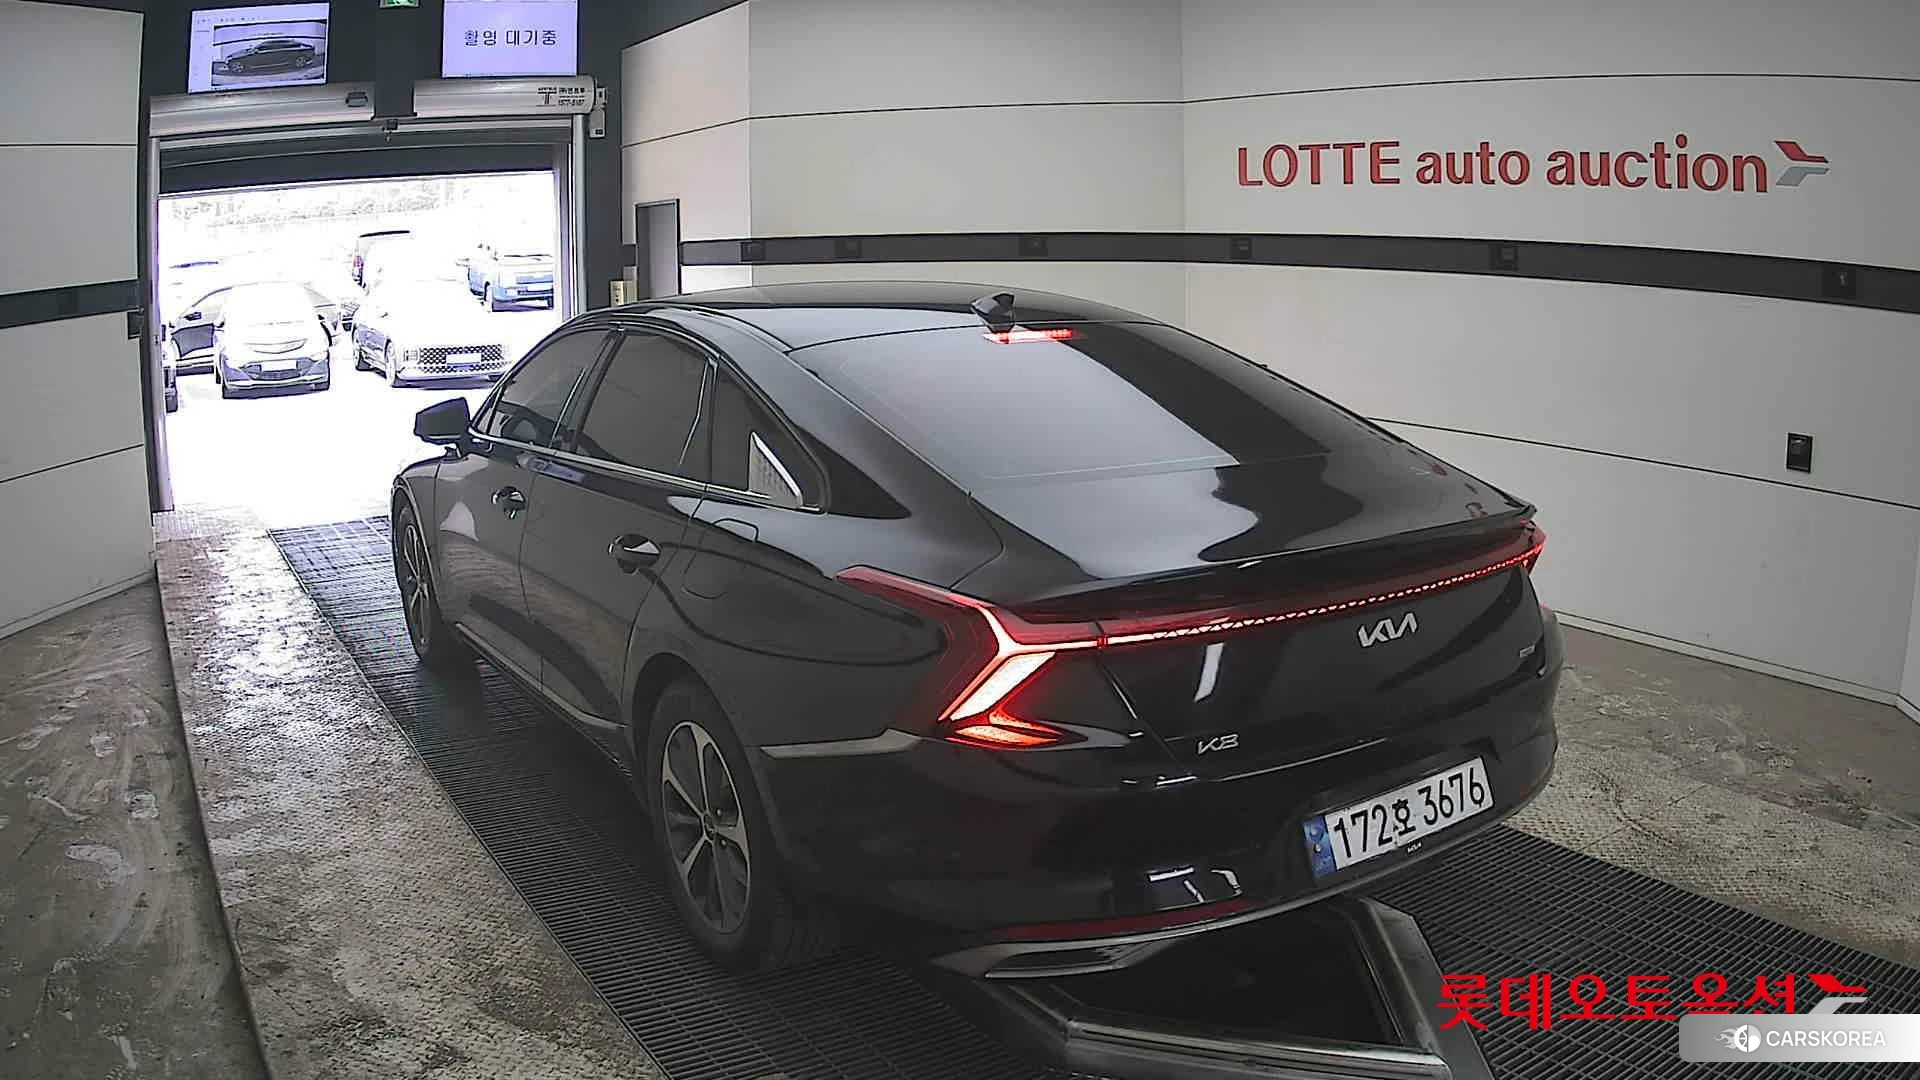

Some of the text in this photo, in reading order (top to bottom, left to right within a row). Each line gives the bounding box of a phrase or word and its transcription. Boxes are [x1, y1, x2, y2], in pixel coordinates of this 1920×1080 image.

[505, 29, 556, 46] 대기중
[1238, 134, 1768, 193] LOTTE auto auction
[1358, 612, 1417, 647] KIA
[1198, 733, 1239, 754] K8
[1417, 767, 1485, 826] 3676
